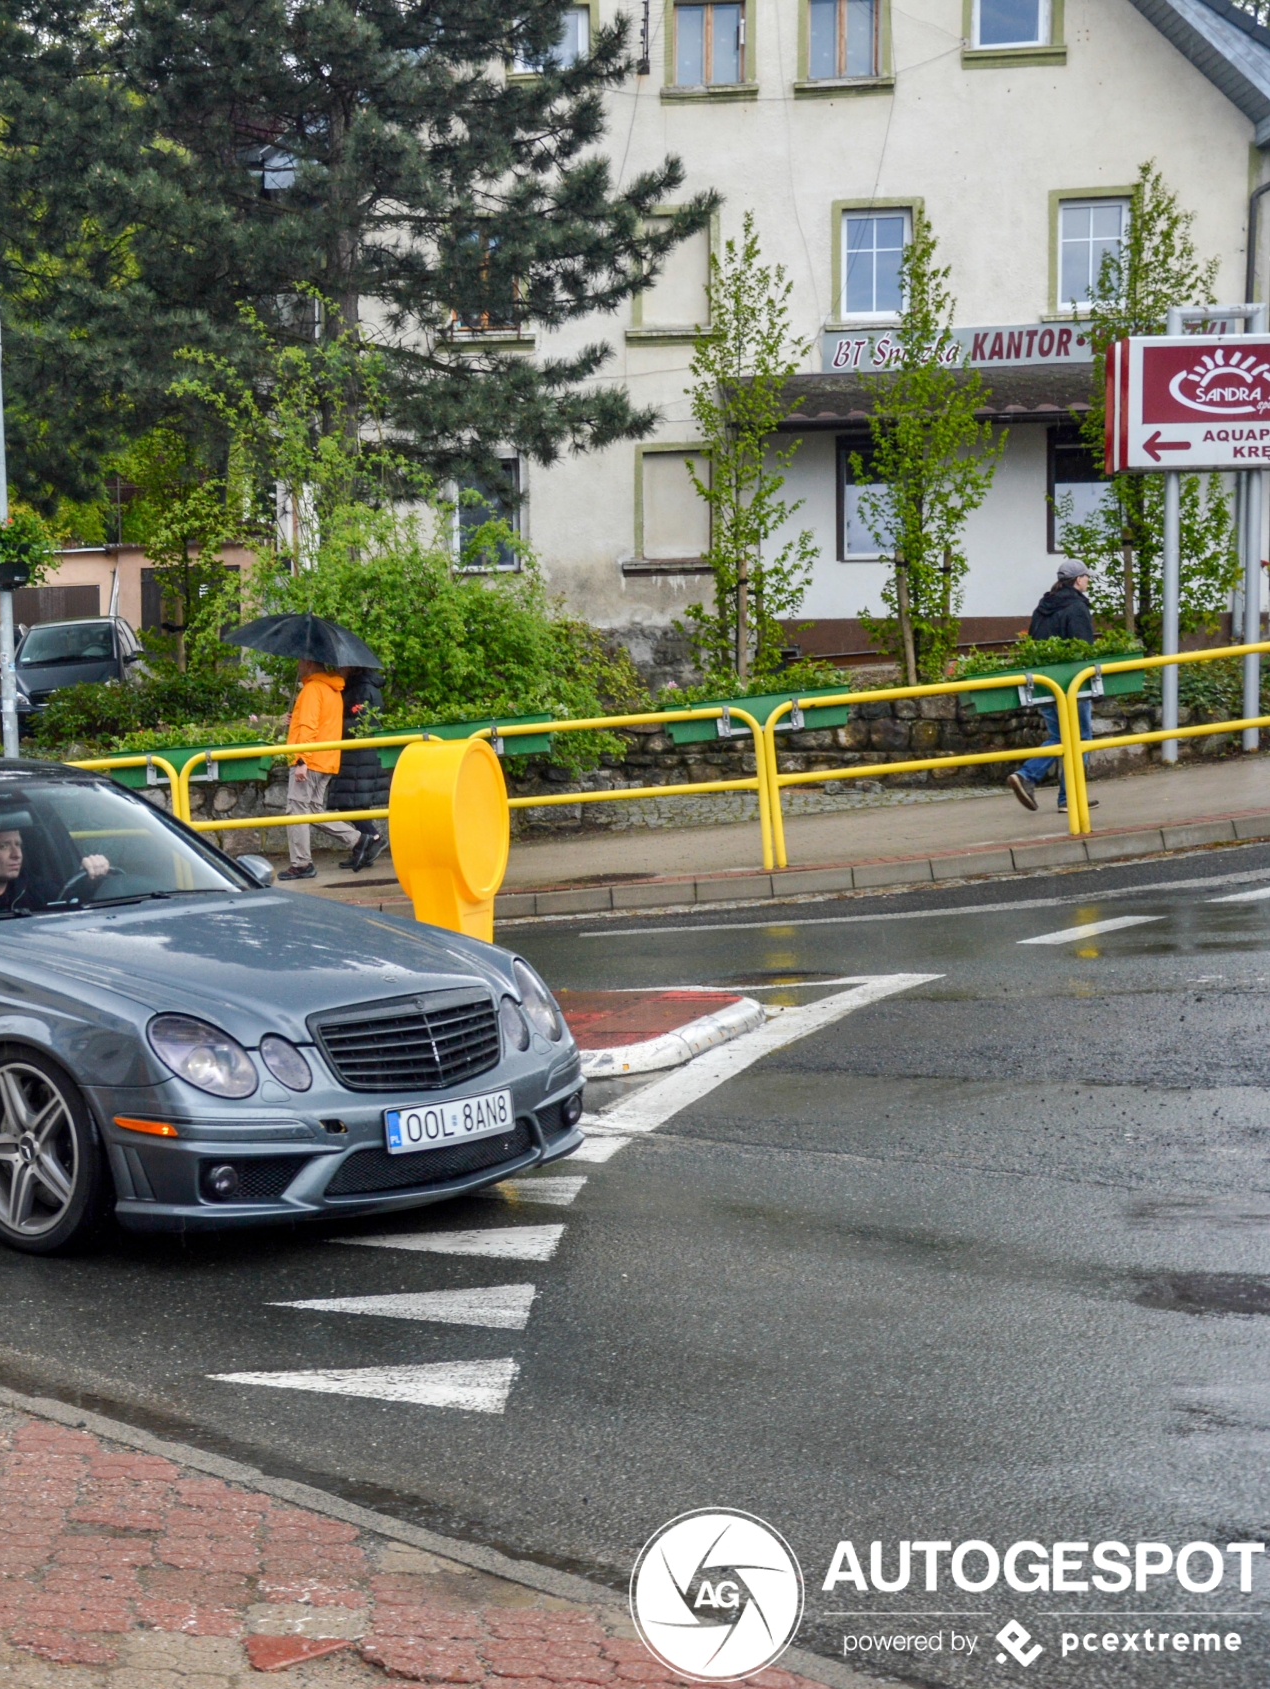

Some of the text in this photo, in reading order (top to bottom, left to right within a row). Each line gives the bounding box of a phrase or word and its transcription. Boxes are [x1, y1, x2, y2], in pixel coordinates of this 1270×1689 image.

[832, 339, 867, 368] BT
[971, 328, 1072, 361] KANTOR
[1196, 387, 1261, 402] SANDRA
[1202, 429, 1270, 442] AQUAP
[463, 1095, 507, 1132] 8AN8
